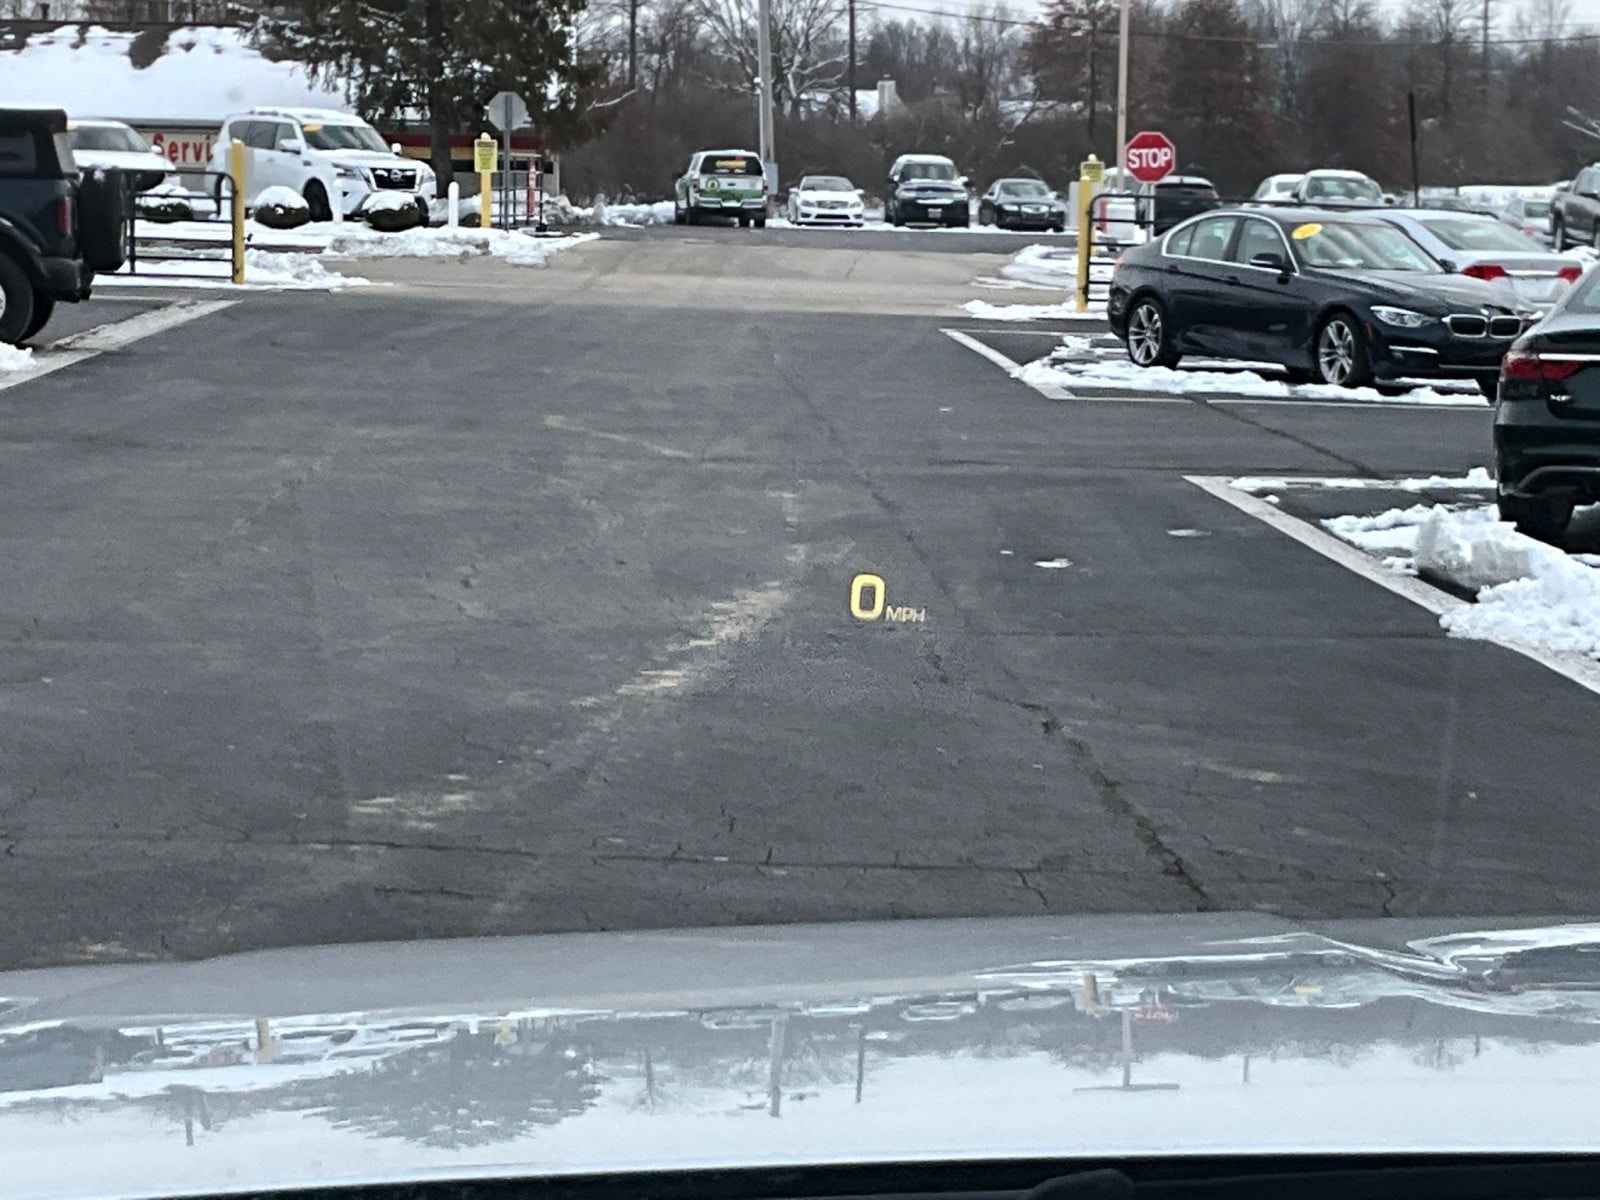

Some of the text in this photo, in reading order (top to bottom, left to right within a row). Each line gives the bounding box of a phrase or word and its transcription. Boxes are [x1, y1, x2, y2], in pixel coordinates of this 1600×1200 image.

[1128, 147, 1171, 168] STOP
[850, 573, 926, 622] 0 MPH
